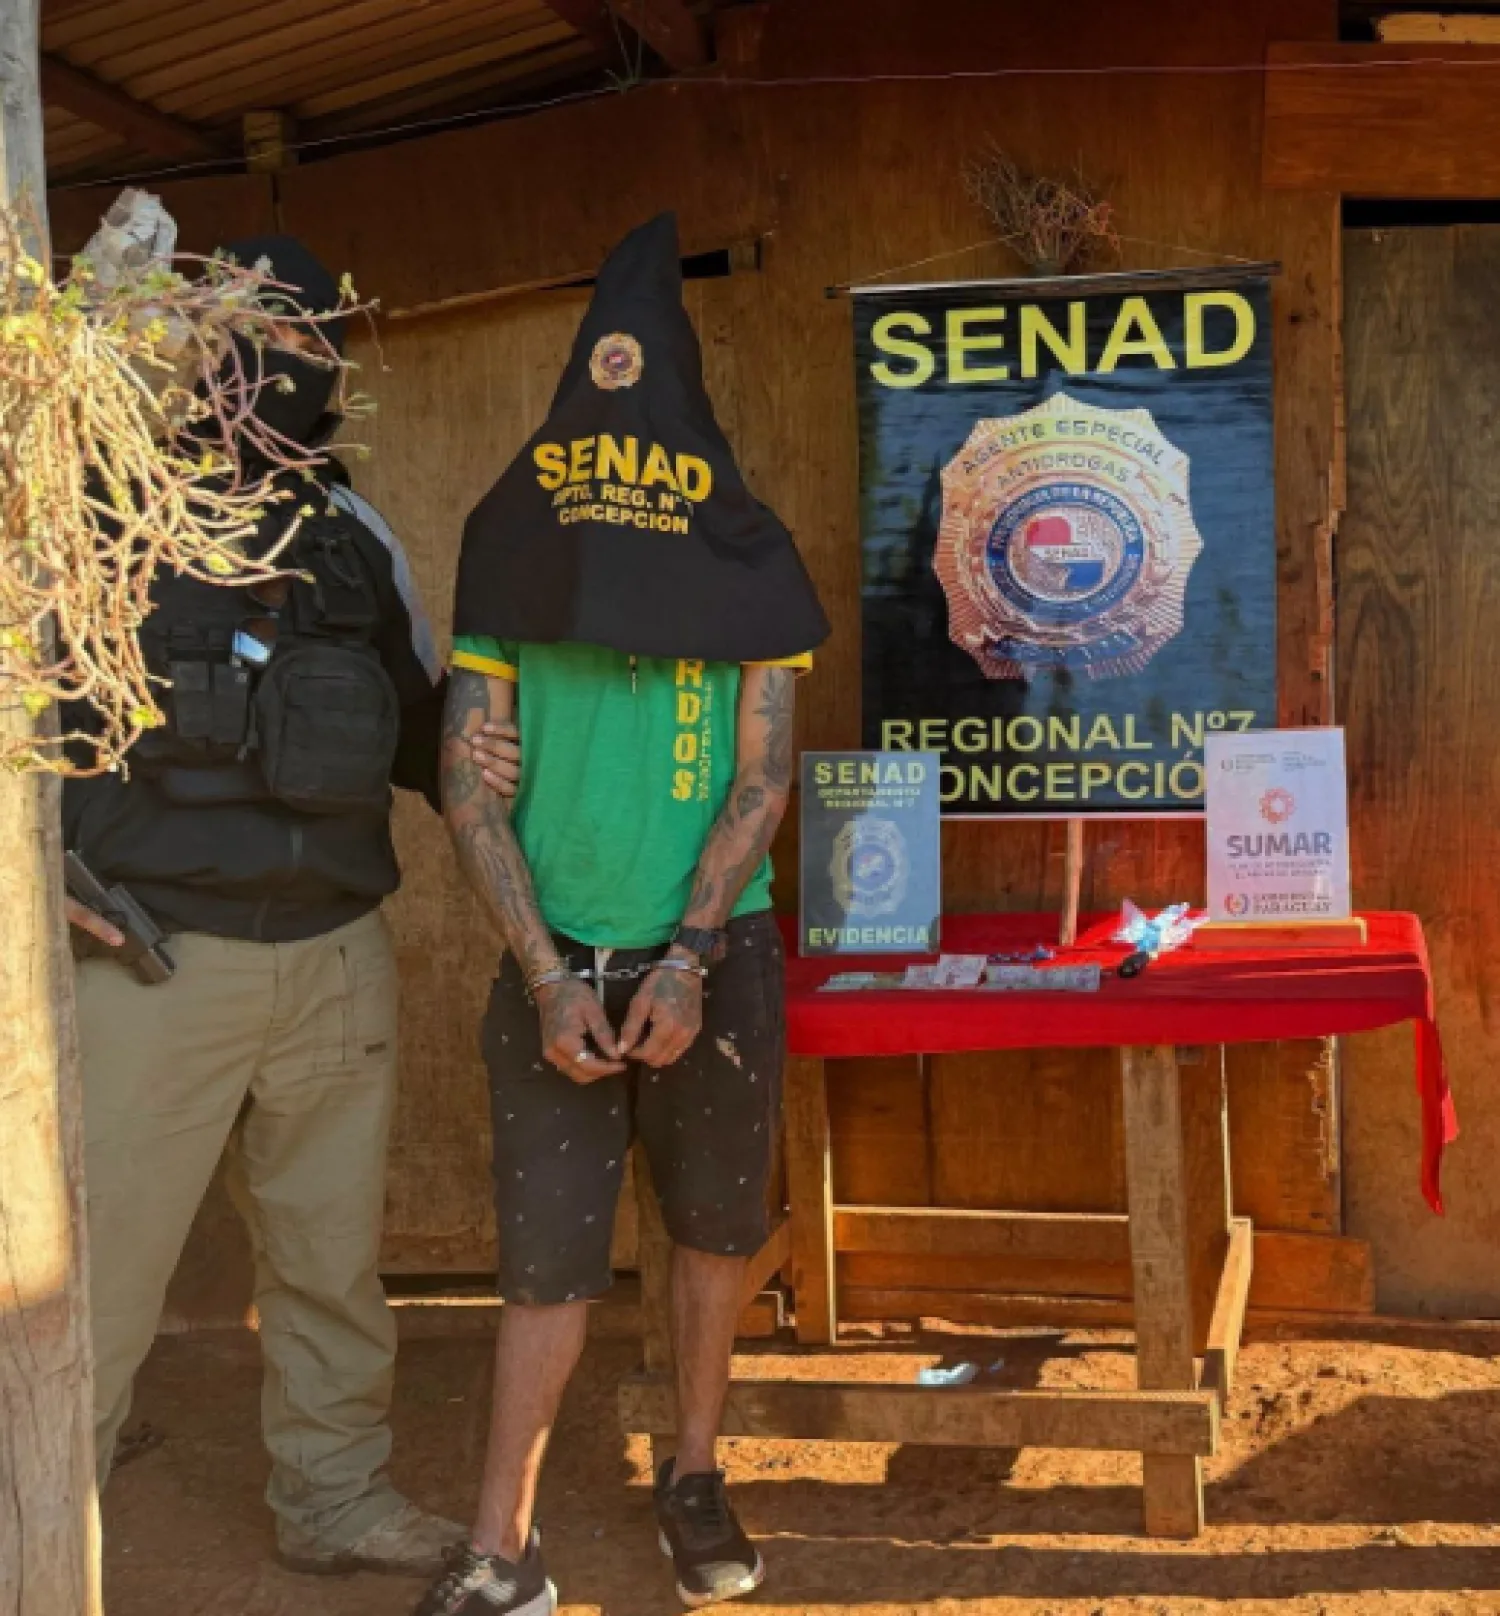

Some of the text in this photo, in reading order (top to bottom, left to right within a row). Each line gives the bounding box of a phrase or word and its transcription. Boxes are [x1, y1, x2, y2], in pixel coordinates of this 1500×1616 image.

[869, 291, 1257, 389] SENAD
[532, 433, 714, 503] SENAD
[962, 419, 1164, 475] AGENTE ESPECIAL
[670, 657, 705, 802] RDOS
[881, 713, 1153, 753] REGIONAL
[814, 761, 926, 785] SENAD
[939, 750, 1206, 802] ONCEPCIÓ
[1226, 831, 1333, 858] SUMAR
[808, 924, 930, 947] EVIDENCIA
